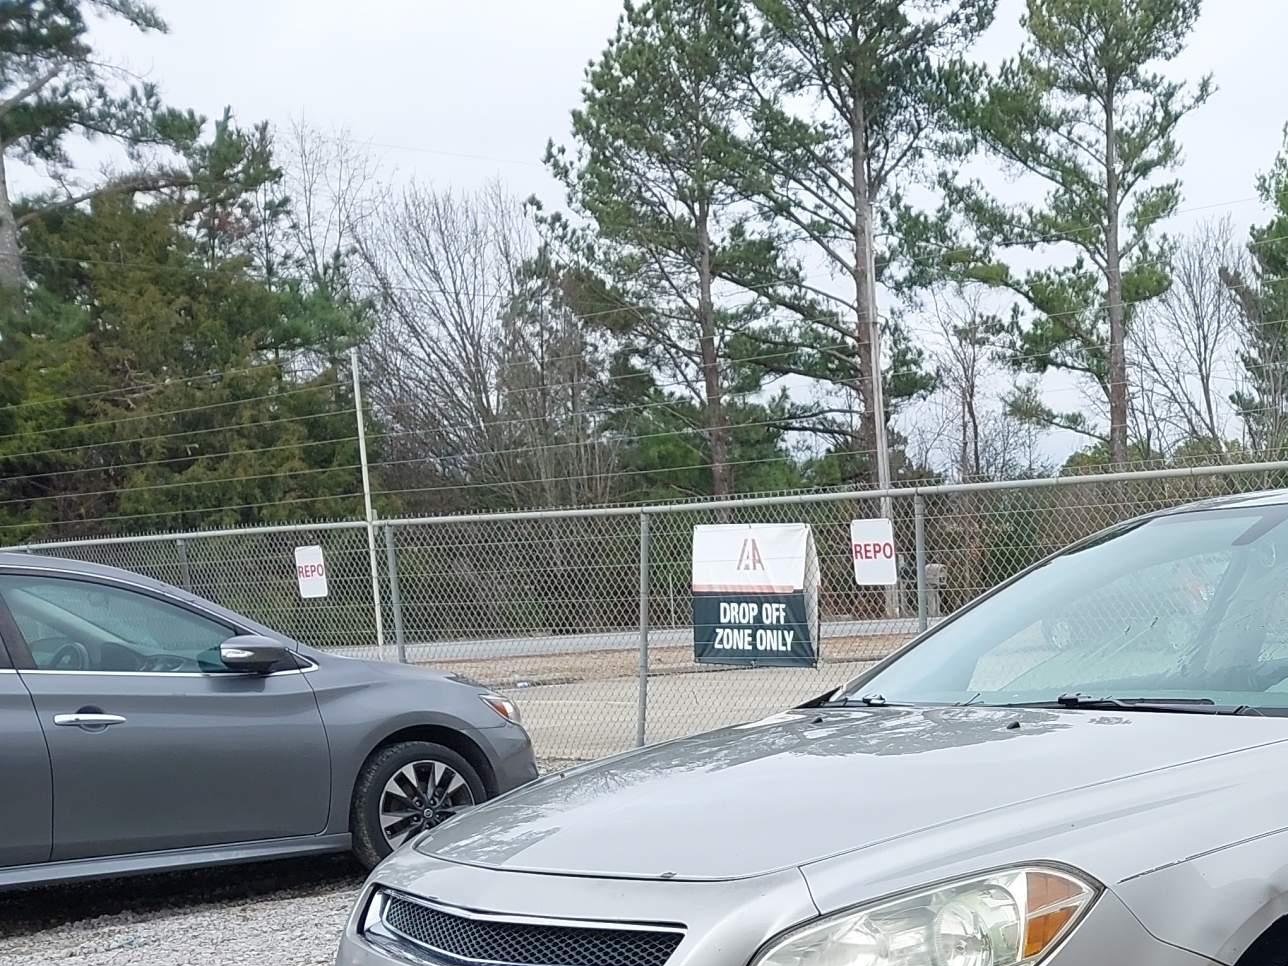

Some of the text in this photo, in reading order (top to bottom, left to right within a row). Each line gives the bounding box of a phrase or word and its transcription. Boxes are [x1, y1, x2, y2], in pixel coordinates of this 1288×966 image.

[853, 542, 893, 560] REPO
[297, 564, 325, 578] REPO
[719, 602, 786, 625] DROP OFF
[714, 628, 794, 651] ZONE ONLY
